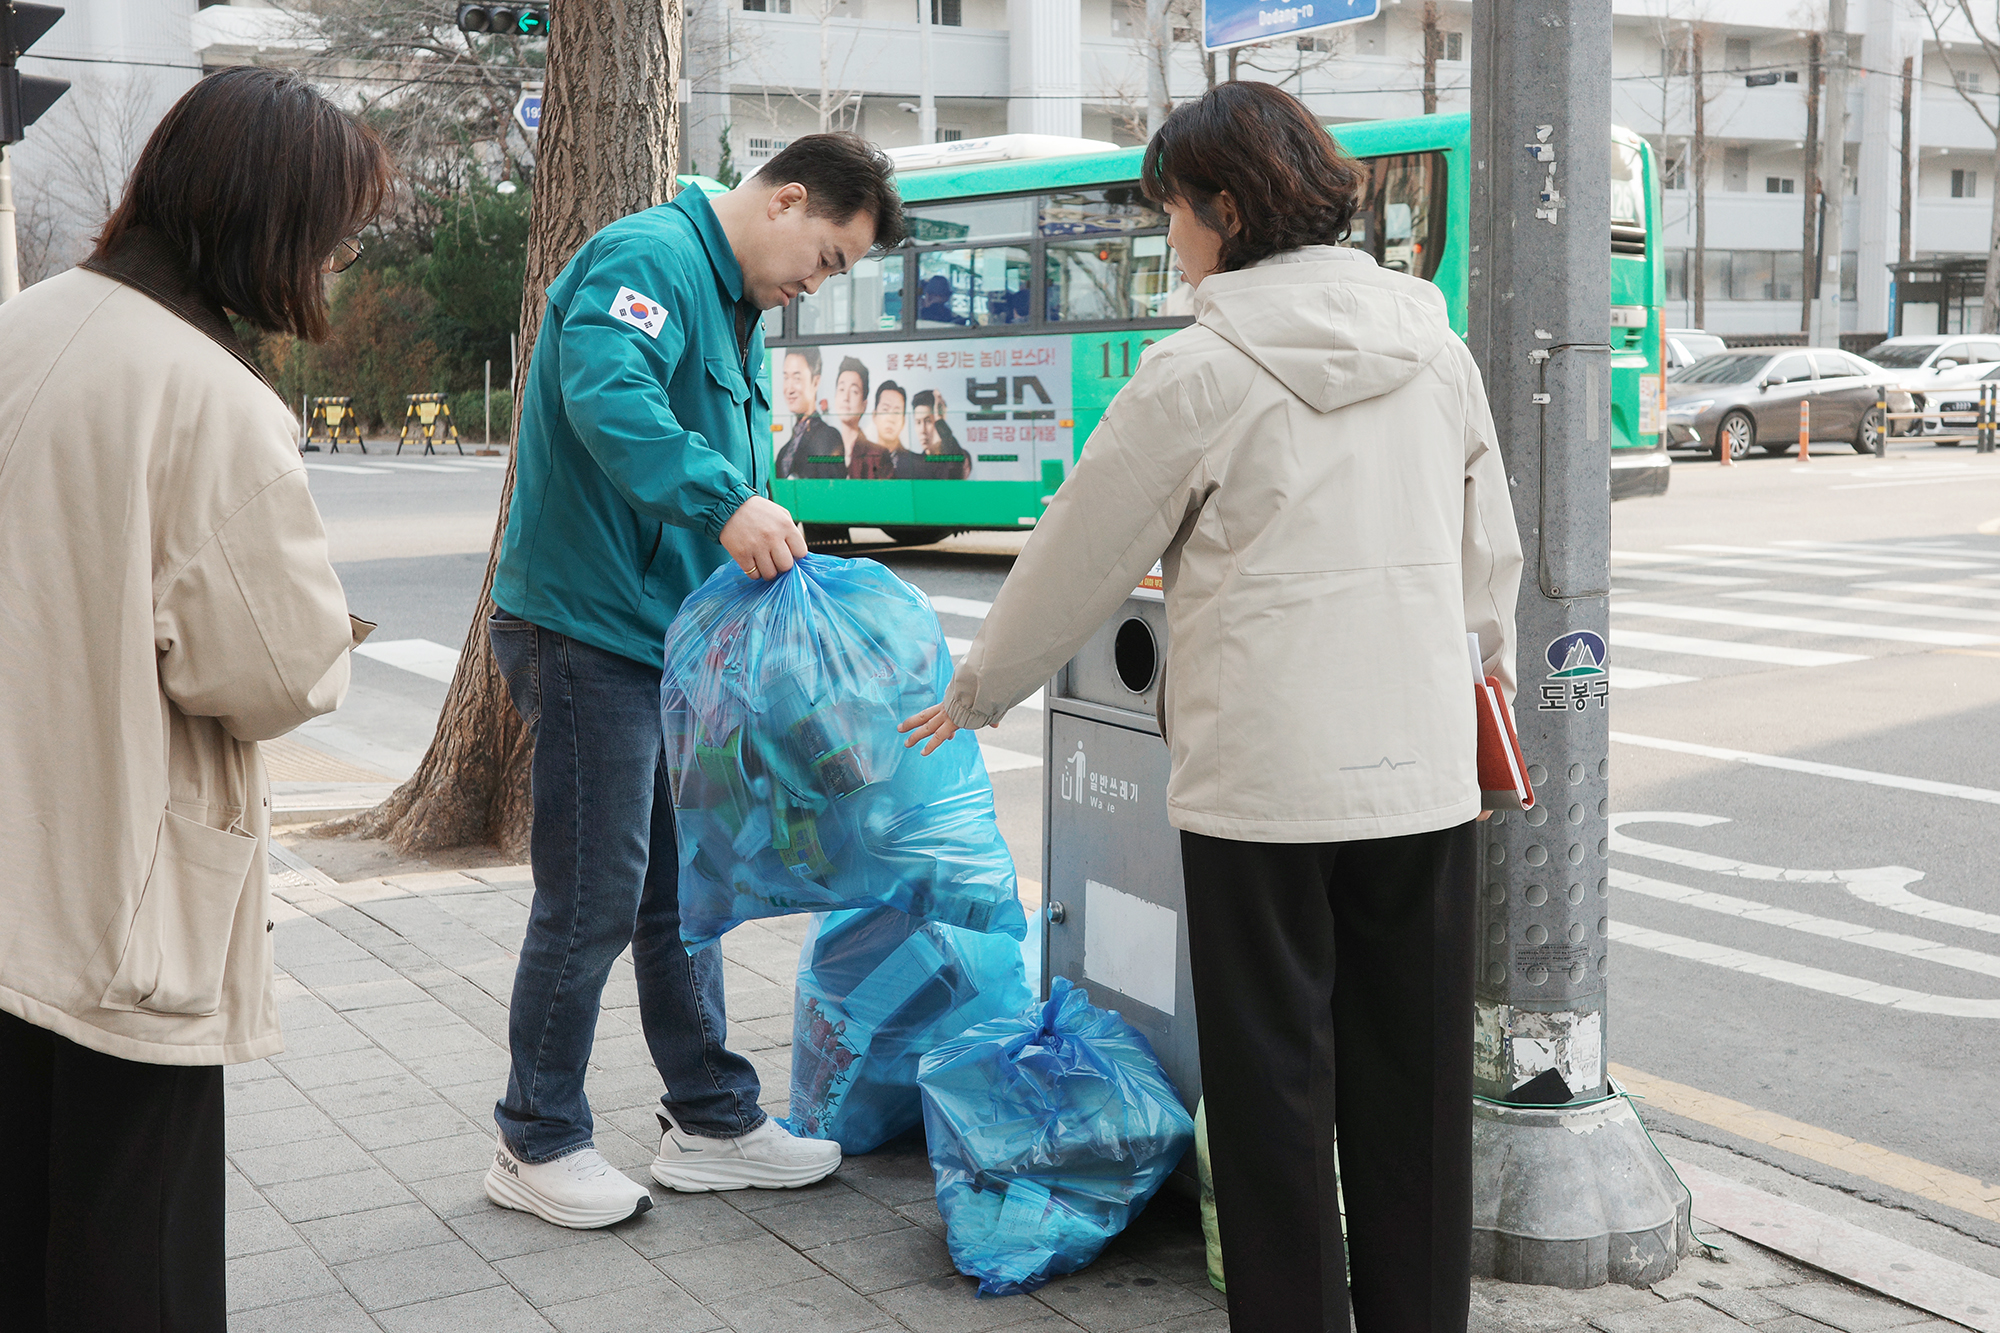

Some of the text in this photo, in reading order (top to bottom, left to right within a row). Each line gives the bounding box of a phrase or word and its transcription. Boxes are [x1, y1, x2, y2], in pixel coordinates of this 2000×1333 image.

[1258, 4, 1314, 26] Dodang-ro
[887, 347, 1056, 372] 올 추석, 웃기는 놈이 보스다!
[1098, 339, 1156, 378] 11
[966, 376, 1053, 421] 보스
[966, 426, 1056, 442] 10월 극장 대개봉
[1538, 679, 1609, 712] 도봉구
[1089, 771, 1139, 803] 일반쓰레기
